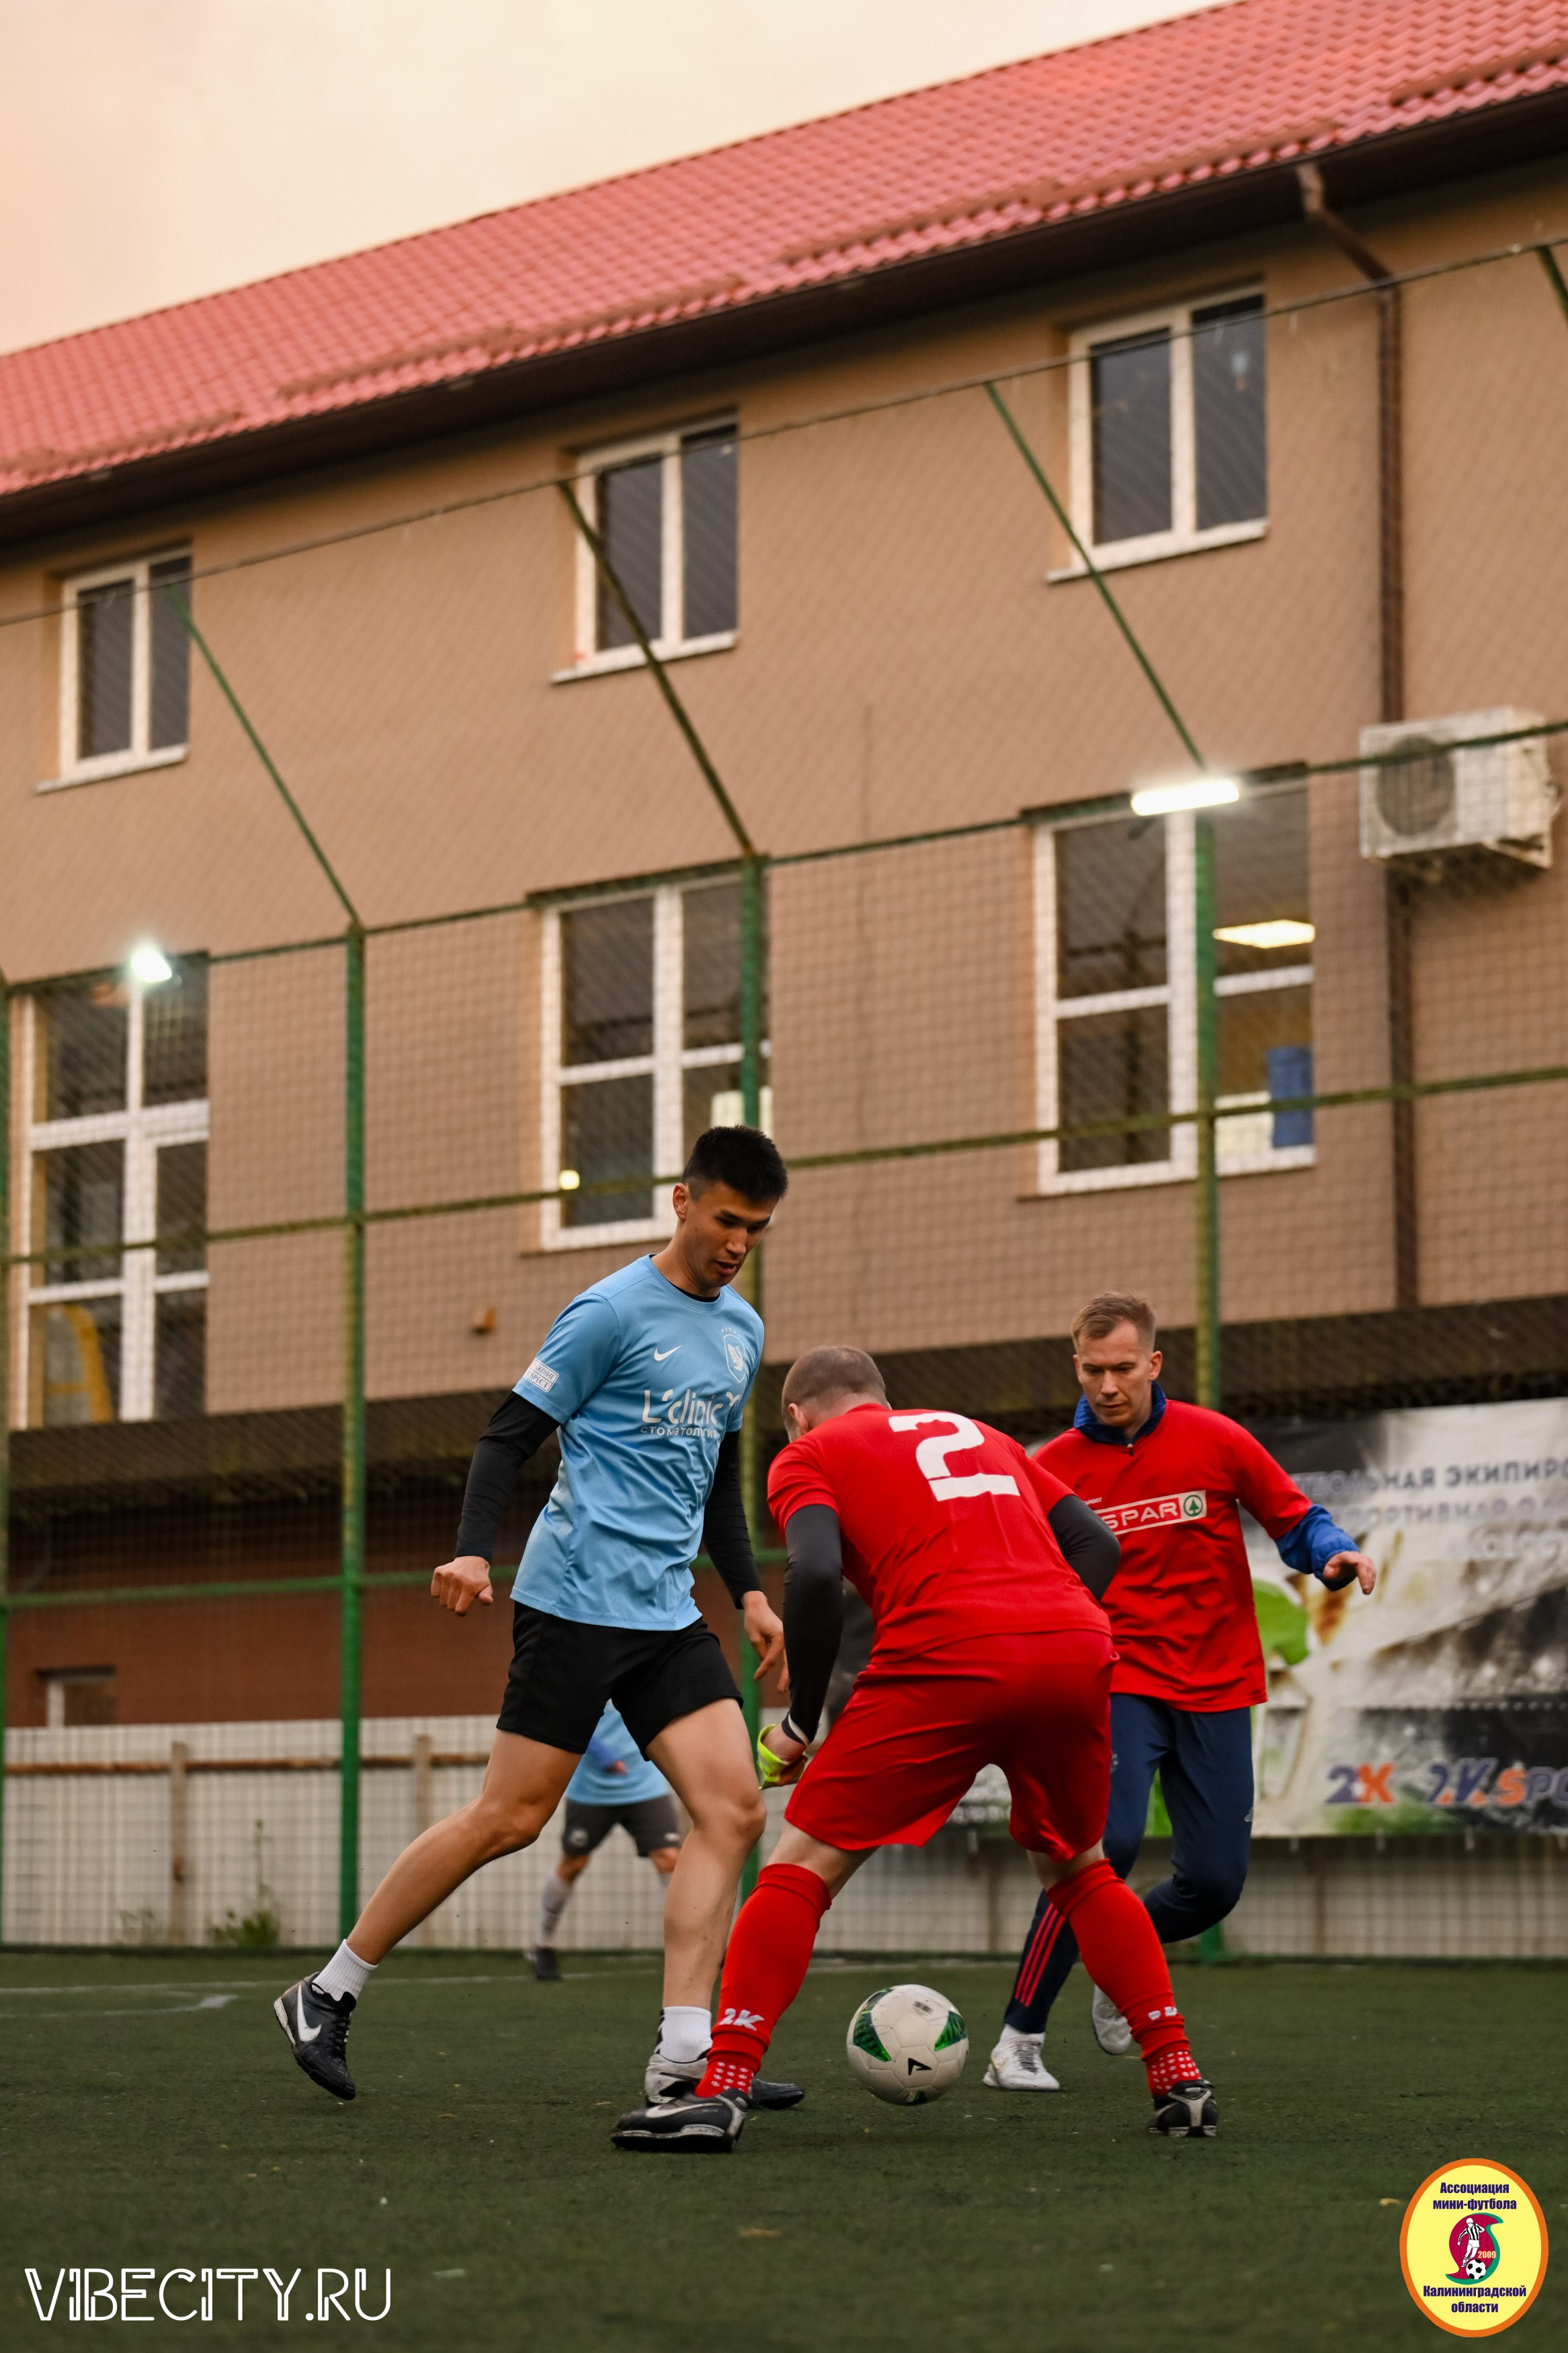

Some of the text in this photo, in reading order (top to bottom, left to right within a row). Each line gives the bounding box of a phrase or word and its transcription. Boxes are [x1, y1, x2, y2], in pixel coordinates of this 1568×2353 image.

[528, 1371, 549, 1388] SPECT
[889, 1412, 1020, 1501] 2
[1102, 1502, 1178, 1529] SPAR
[1325, 1761, 1395, 1804] 2K
[719, 2007, 765, 2032] 2K
